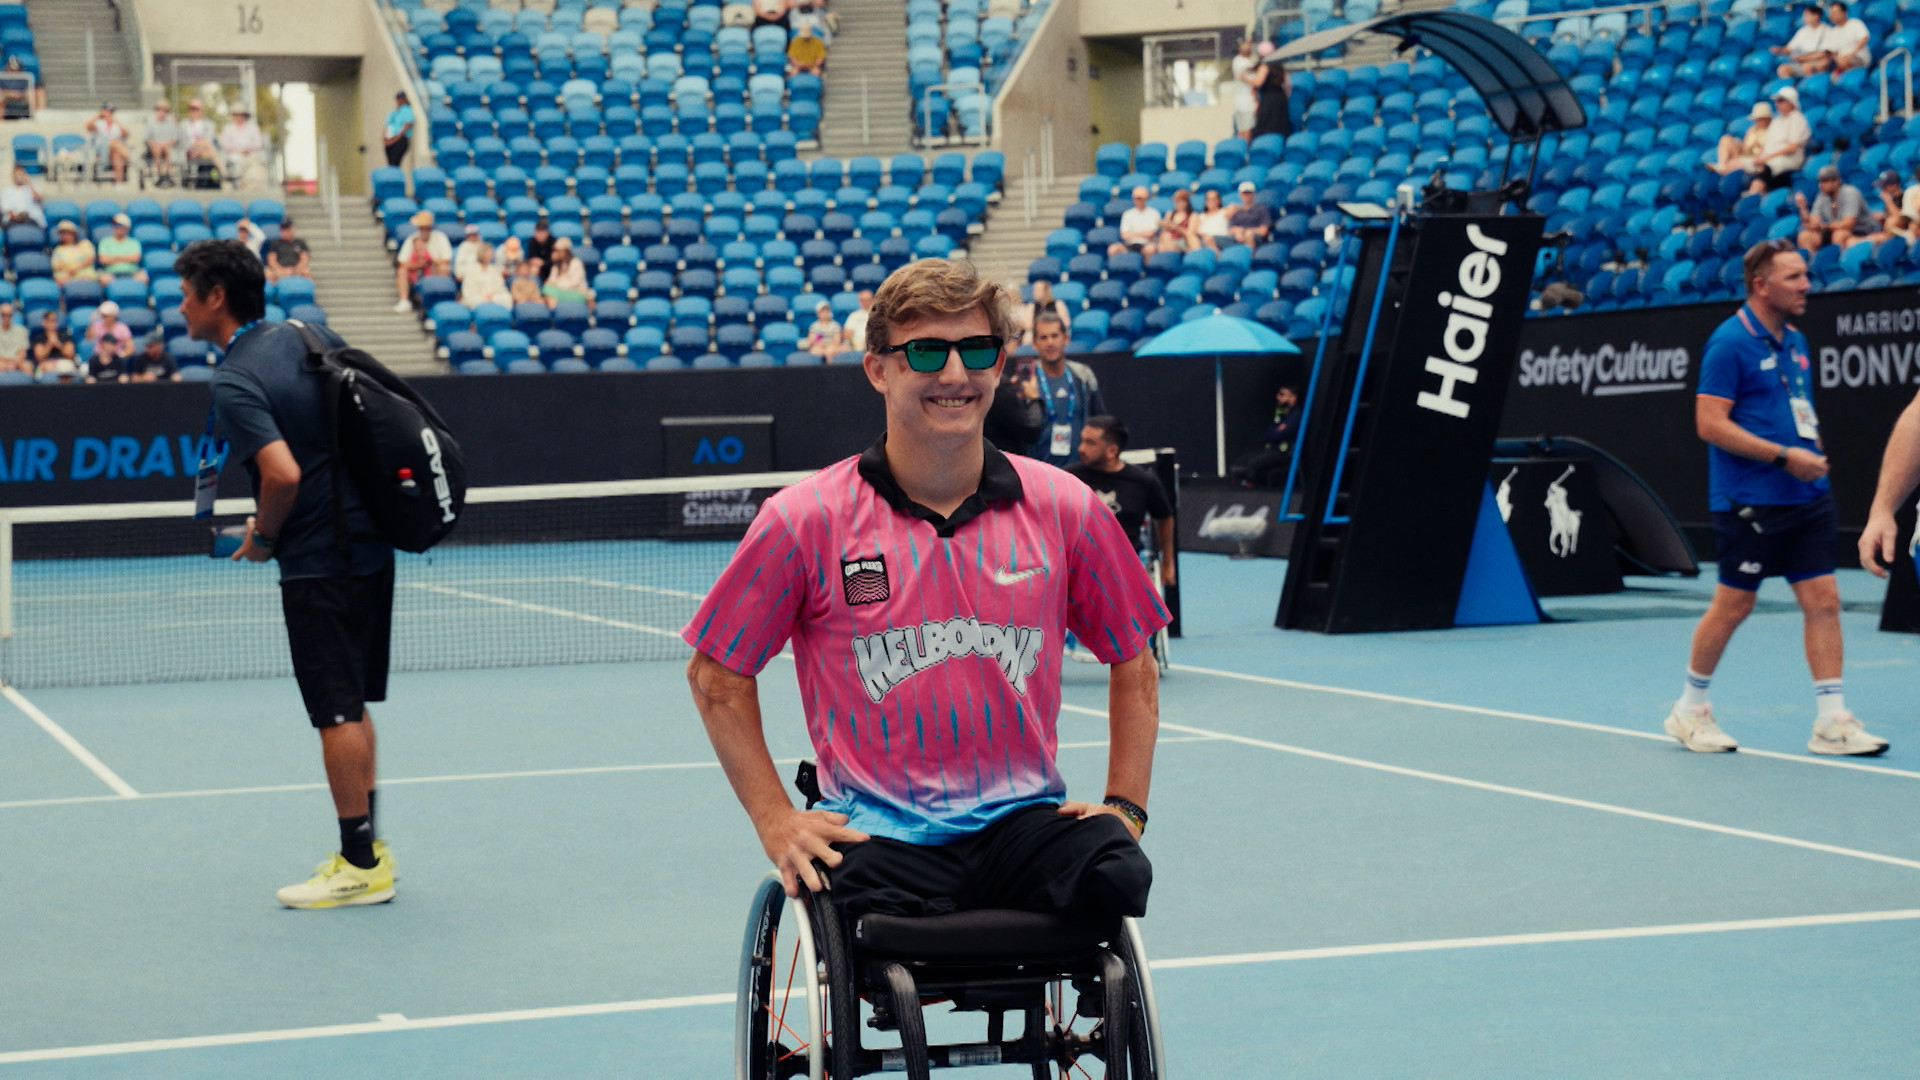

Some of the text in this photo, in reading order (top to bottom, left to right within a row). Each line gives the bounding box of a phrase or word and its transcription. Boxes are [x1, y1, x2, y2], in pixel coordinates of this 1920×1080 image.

[238, 4, 263, 34] 16
[1416, 223, 1508, 419] Haier
[1518, 340, 1690, 396] SafetyCulture
[70, 433, 230, 481] DRAW
[421, 427, 456, 523] HEAD
[692, 435, 745, 465] AO
